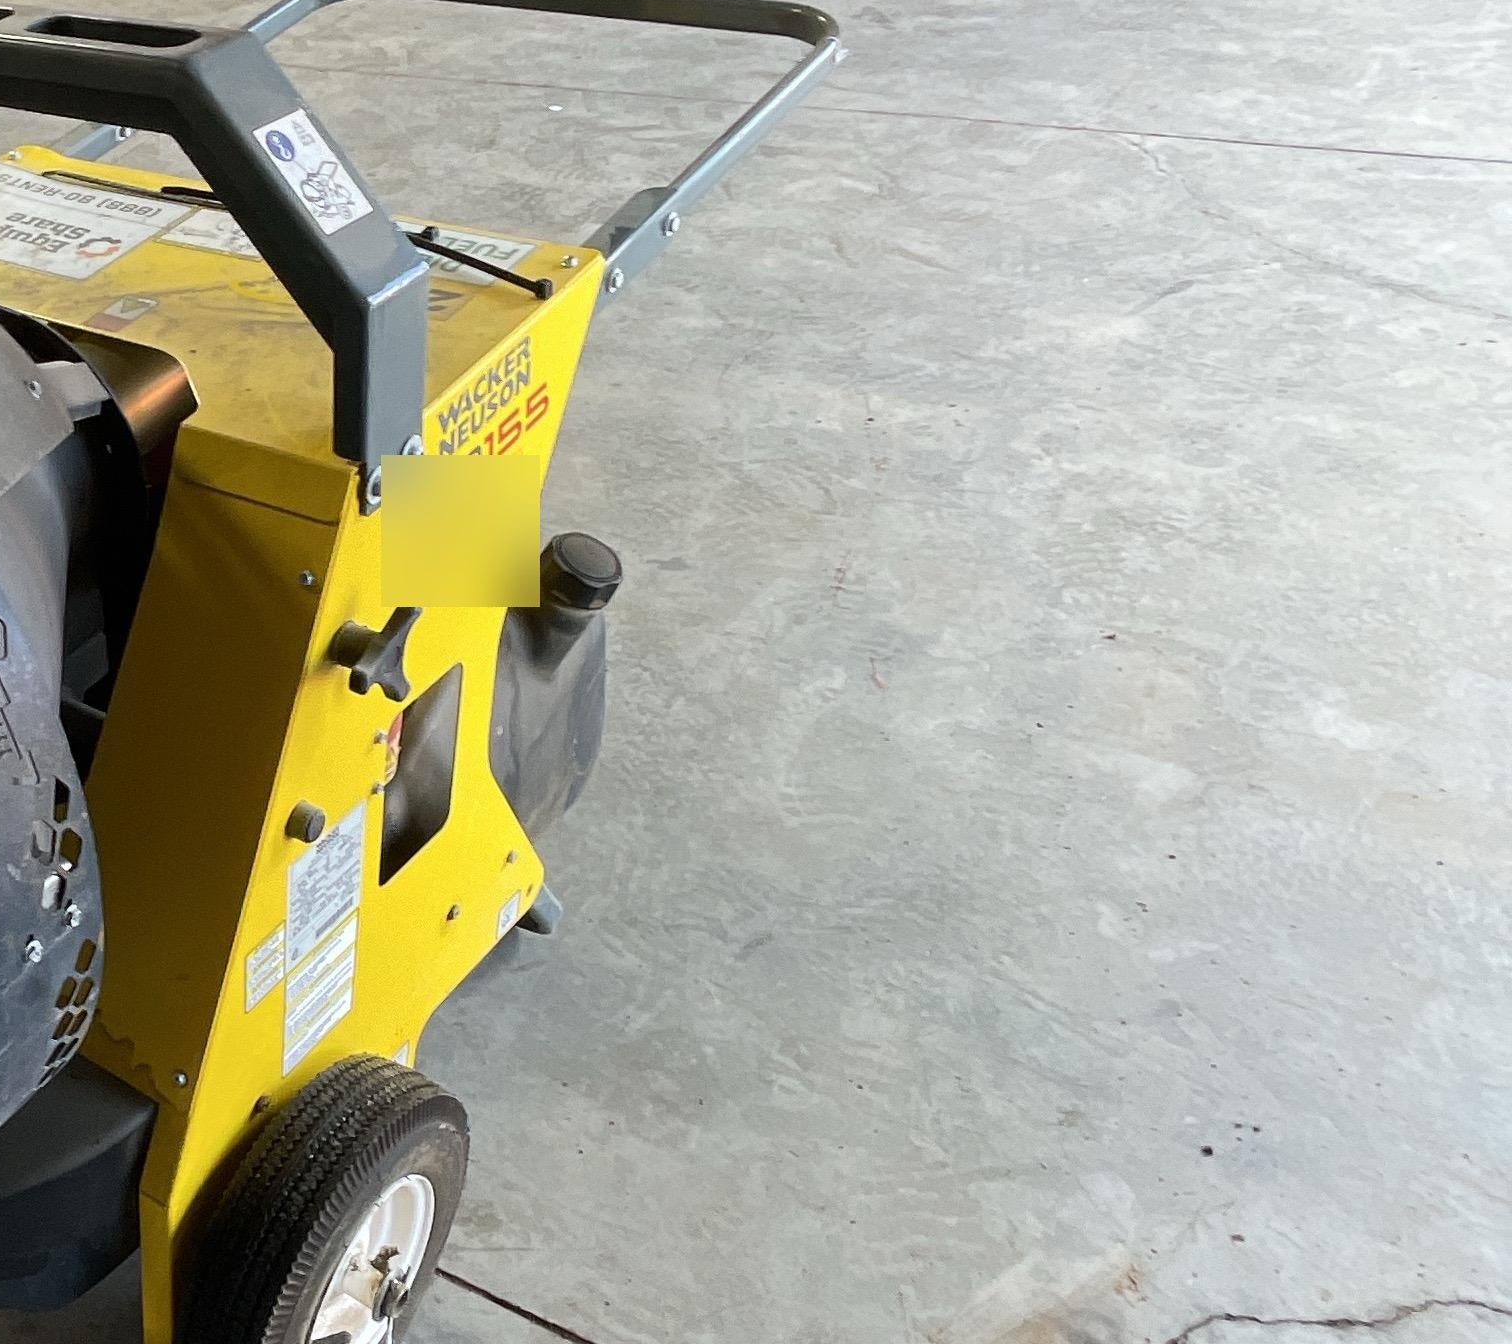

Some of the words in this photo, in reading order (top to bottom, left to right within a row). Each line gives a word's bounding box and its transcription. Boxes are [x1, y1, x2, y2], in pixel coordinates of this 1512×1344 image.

[4, 211, 91, 241] Share
[438, 336, 531, 434] WACKER
[439, 360, 531, 455] NEUSON
